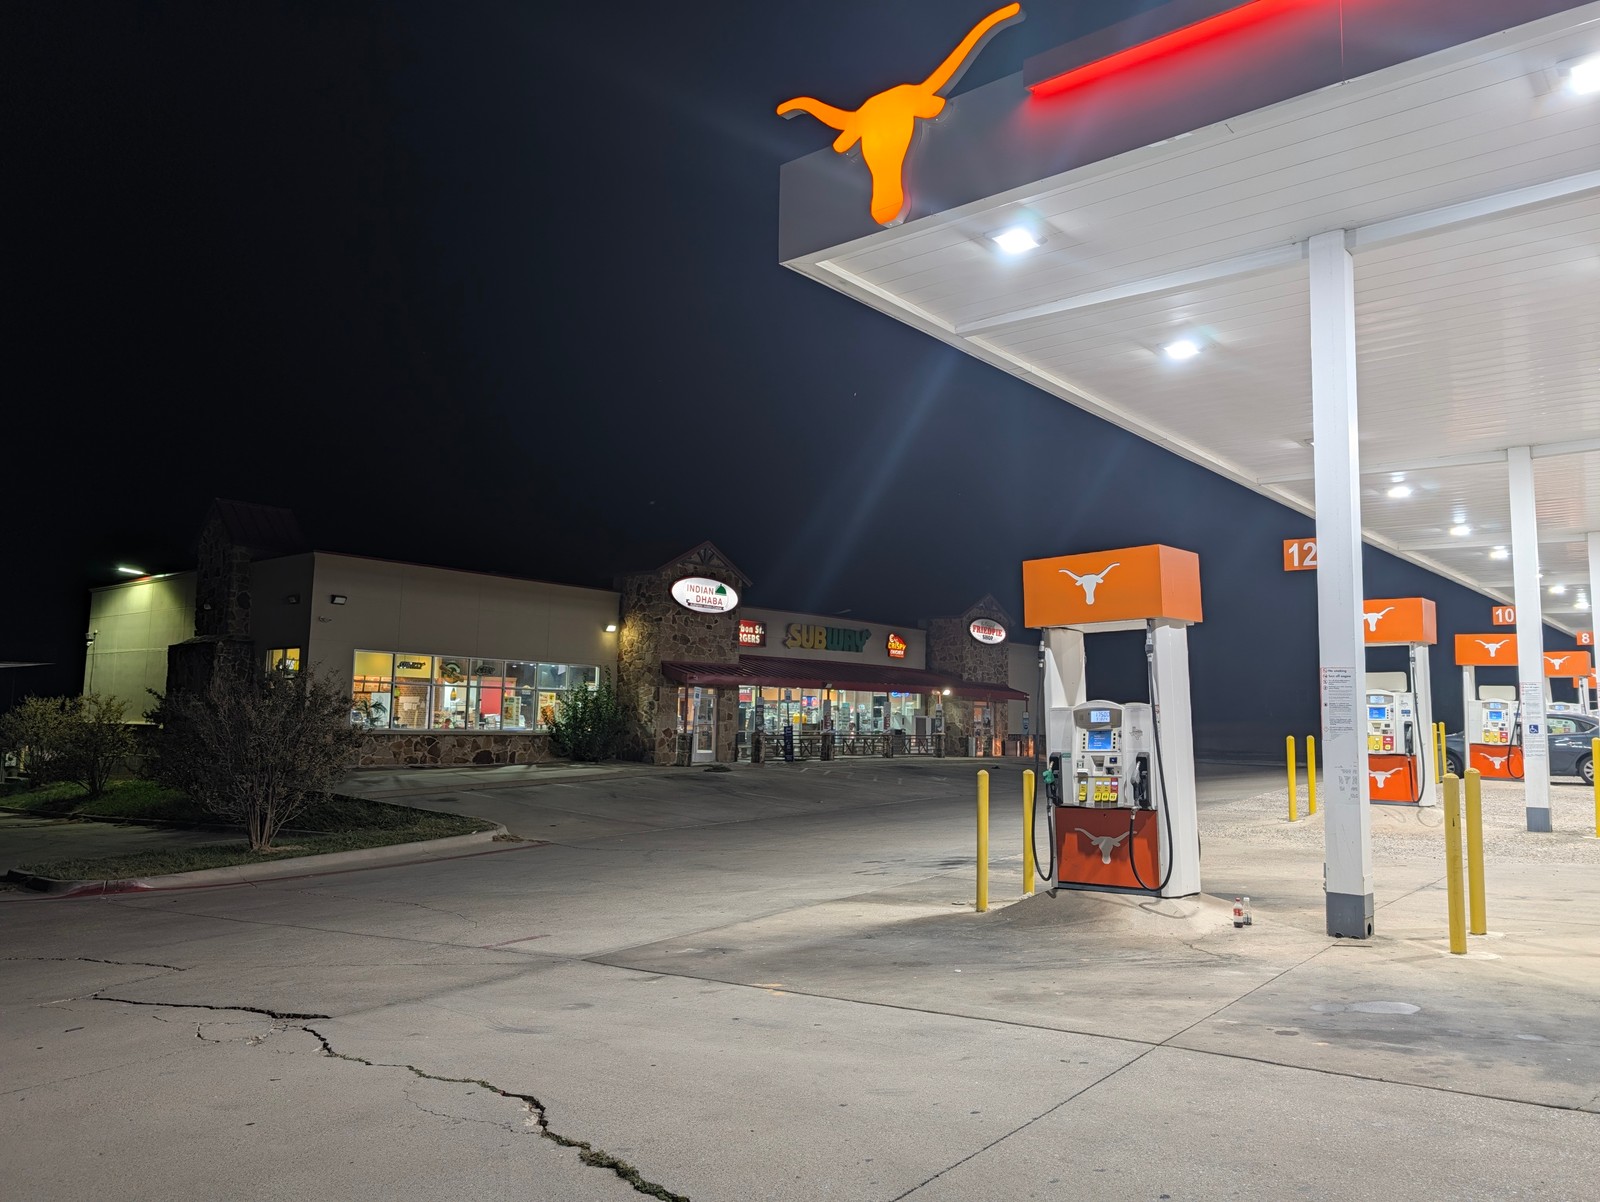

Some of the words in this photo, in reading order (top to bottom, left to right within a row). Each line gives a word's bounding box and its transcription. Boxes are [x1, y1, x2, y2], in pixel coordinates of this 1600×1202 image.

[1288, 542, 1317, 567] 12
[686, 584, 714, 595] INDIAN
[695, 595, 723, 605] DHABA
[1495, 608, 1514, 623] 10
[738, 624, 753, 633] bon
[754, 624, 765, 635] St.
[786, 623, 872, 653] SUBWAY
[1581, 633, 1590, 644] 8
